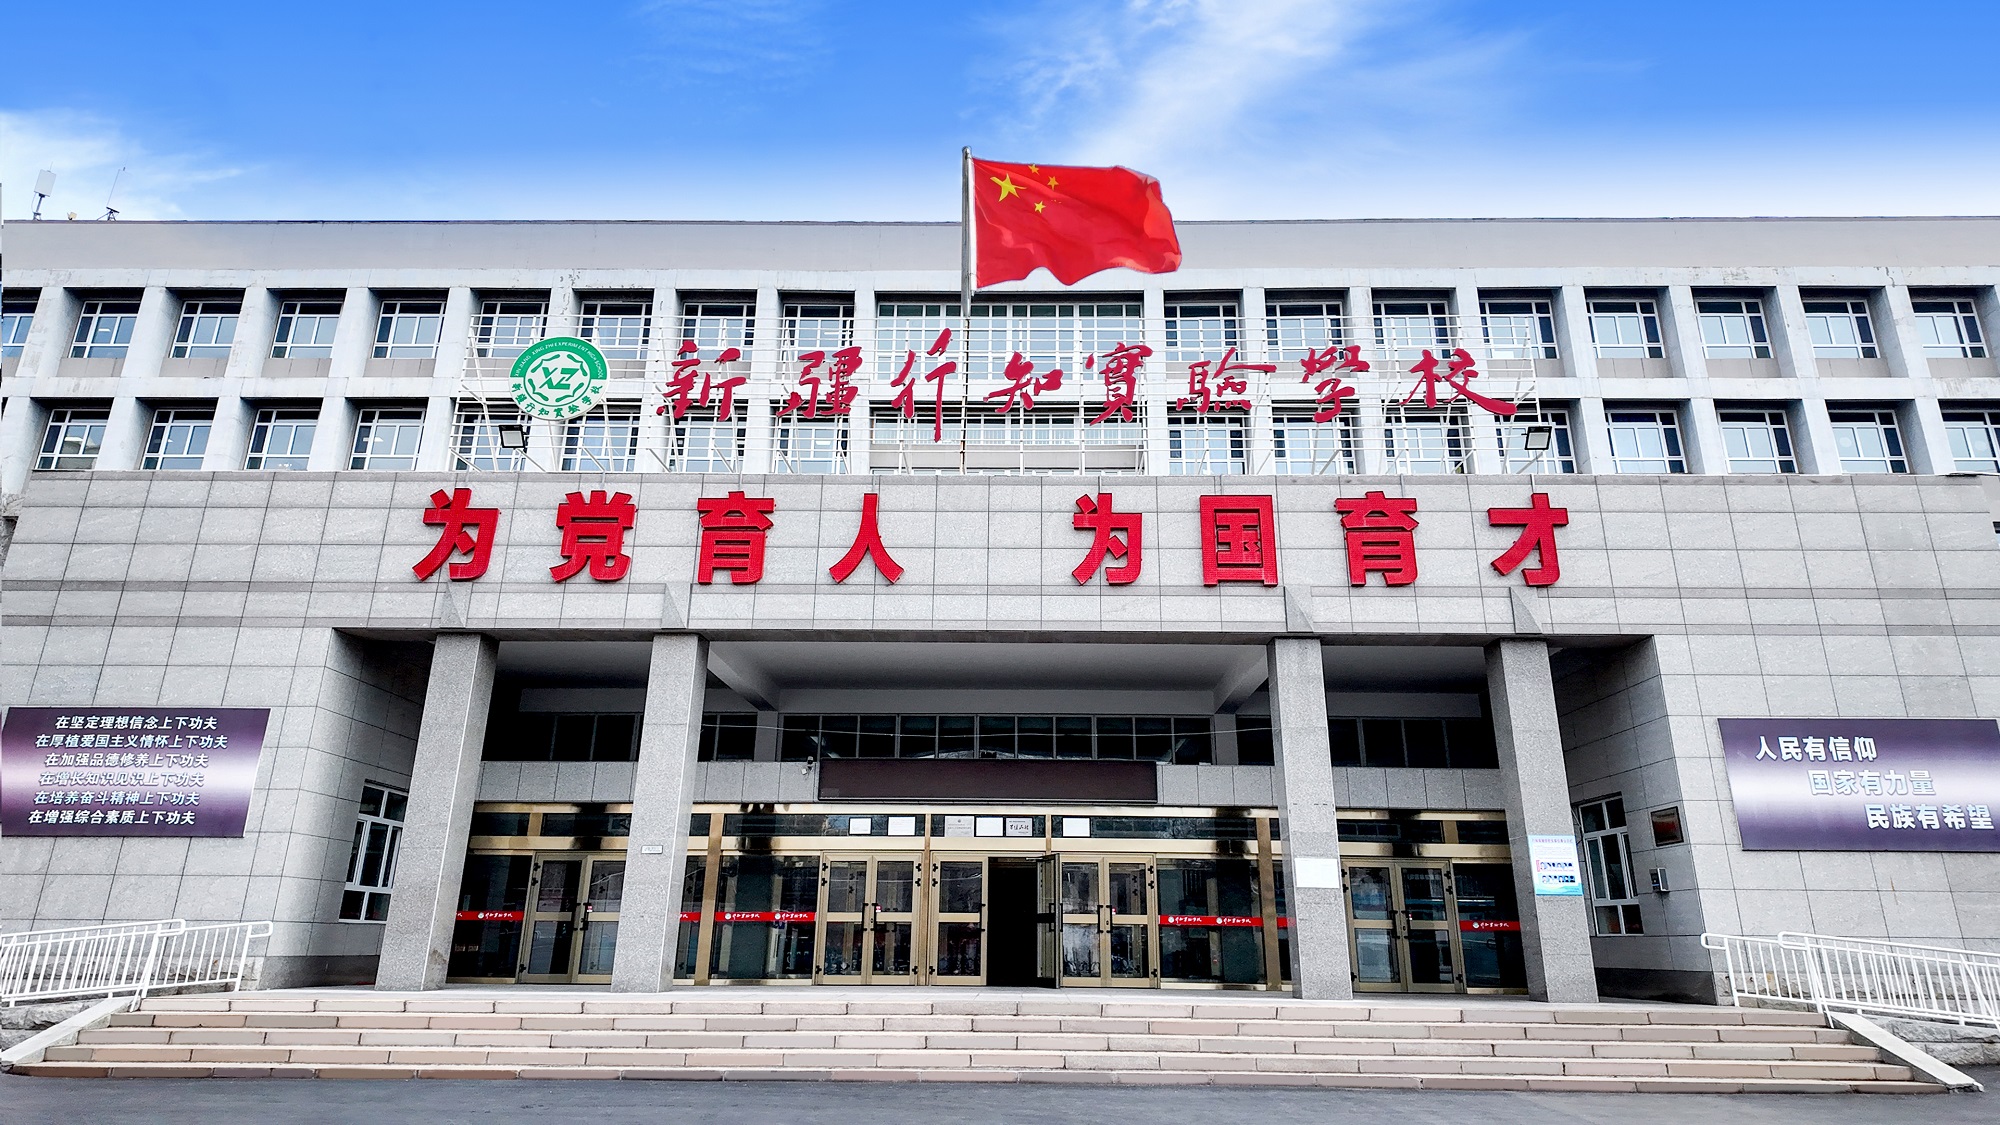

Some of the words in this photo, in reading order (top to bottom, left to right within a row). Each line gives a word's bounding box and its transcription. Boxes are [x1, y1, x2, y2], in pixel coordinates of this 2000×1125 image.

[412, 488, 904, 584] 为党育人
[1072, 491, 1569, 586] 为国育才
[54, 715, 218, 730] 在坚定理想信念上下功夫
[35, 734, 228, 749] 在厚植爱国主义情怀上下功夫
[1755, 735, 1878, 762] 人民有信仰
[44, 752, 209, 768] 在加强品德修养上下功夫
[38, 771, 205, 787] 在增长知识见识上下功夫
[1807, 769, 1936, 796] 国家有力量
[33, 790, 200, 806] 在培养奋斗精神上下功夫
[27, 809, 196, 825] 在增强综合素质上下功夫
[1863, 803, 1995, 831] 民族有希望
